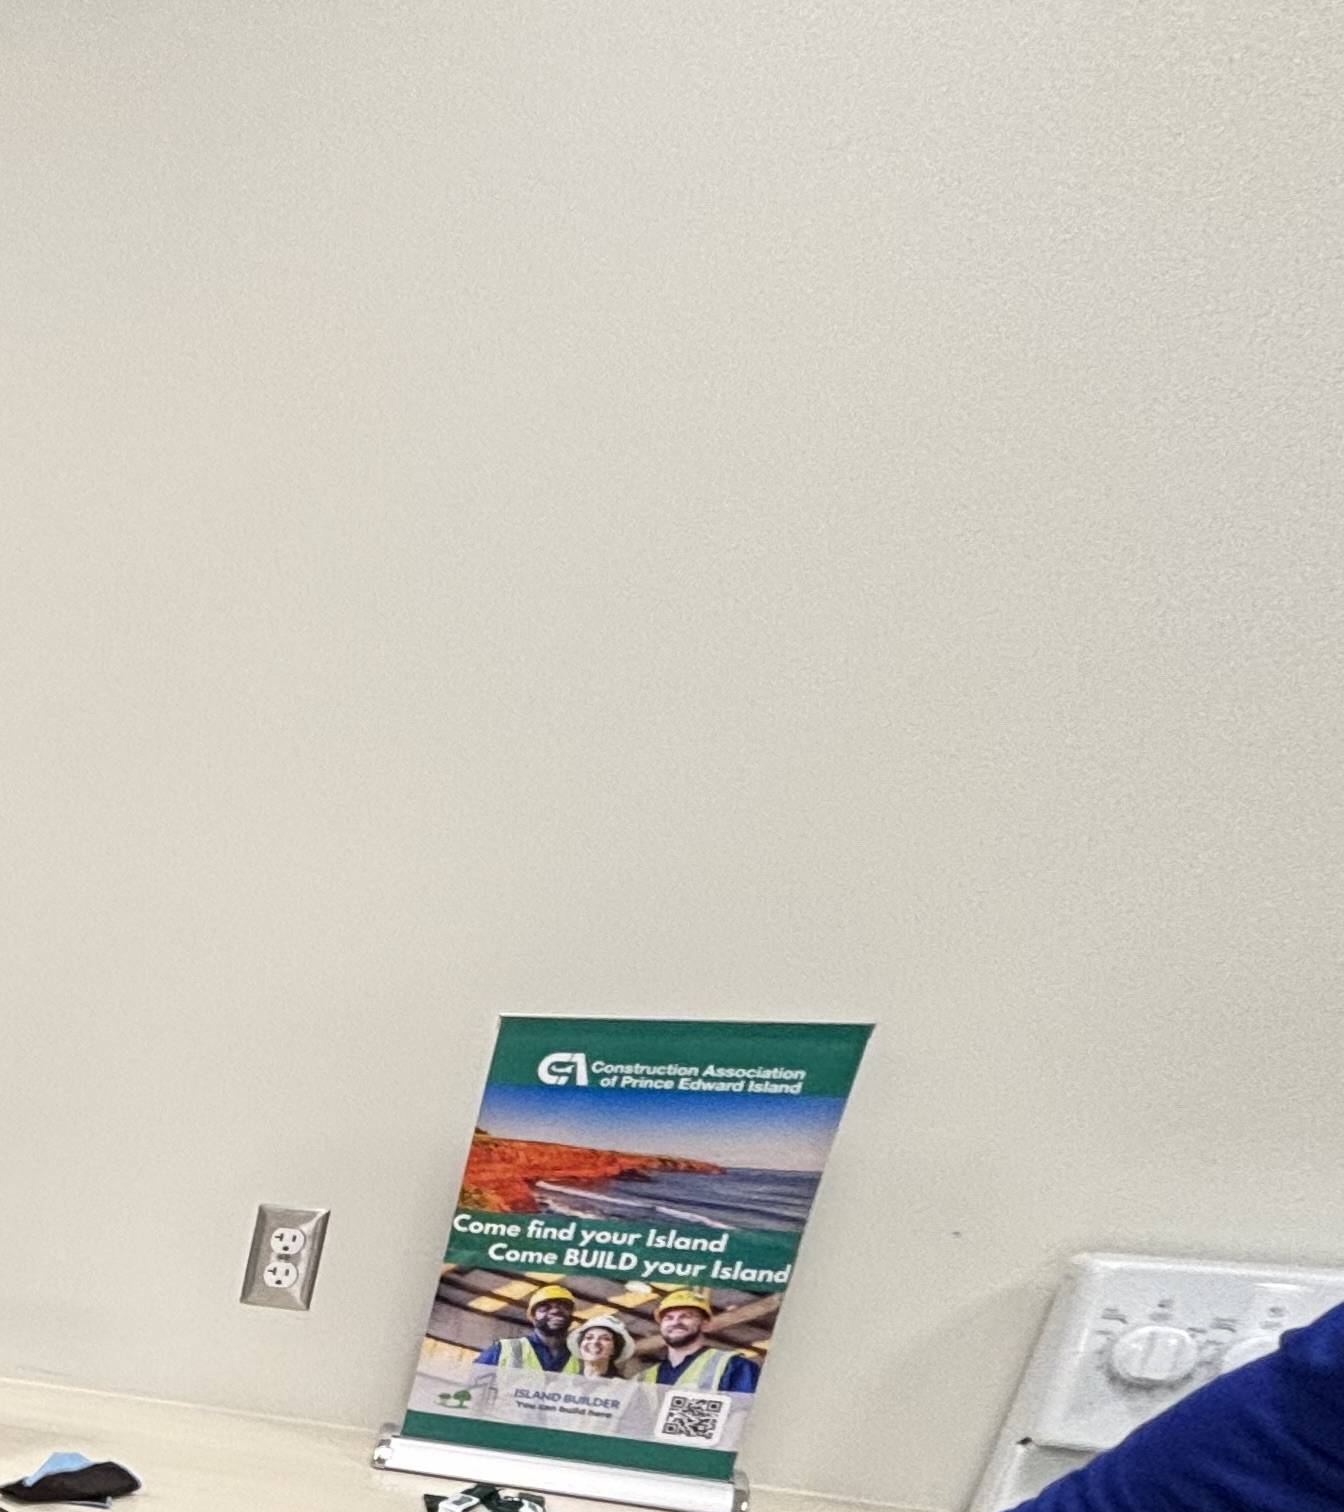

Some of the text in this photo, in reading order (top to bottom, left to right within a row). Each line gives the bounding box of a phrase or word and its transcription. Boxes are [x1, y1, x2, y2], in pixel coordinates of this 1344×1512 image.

[591, 1060, 807, 1080] Construction Association
[600, 1075, 804, 1095] of Prince Edward Island
[453, 1213, 730, 1253] Come find your Island
[487, 1242, 792, 1284] Come BUILD your Island
[514, 1388, 621, 1409] ISLAND BUILDER
